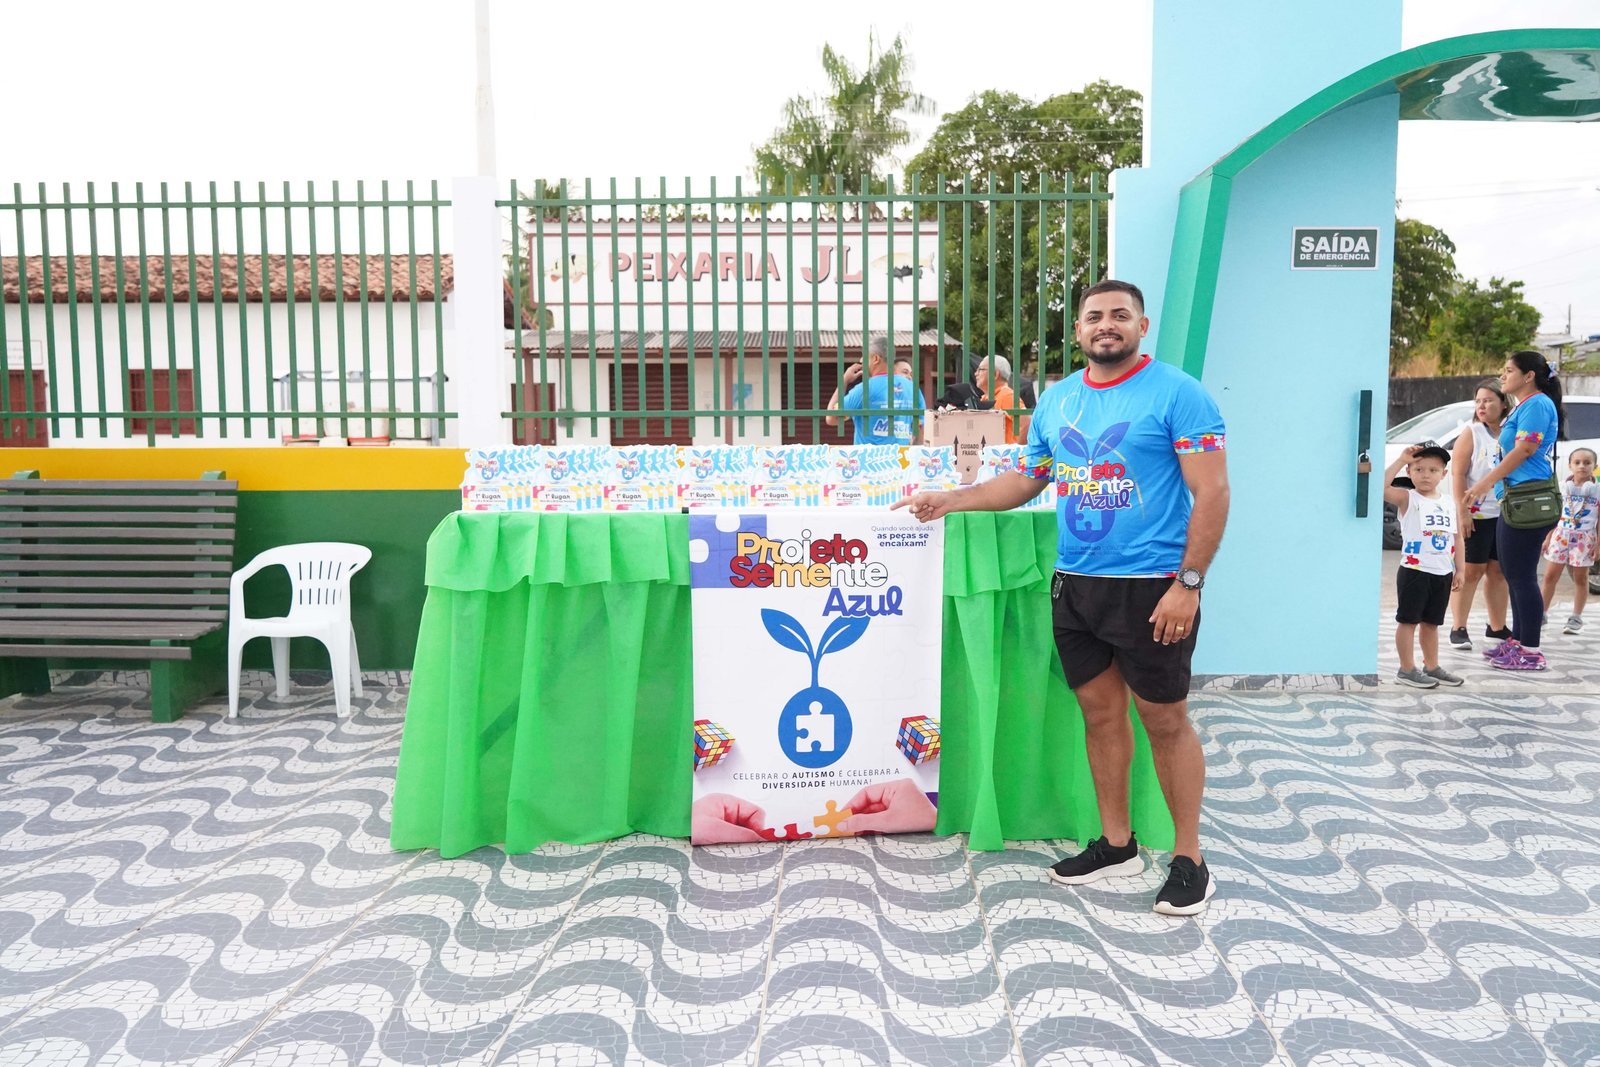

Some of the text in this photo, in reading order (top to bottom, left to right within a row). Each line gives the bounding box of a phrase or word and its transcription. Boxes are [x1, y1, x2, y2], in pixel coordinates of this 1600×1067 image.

[1300, 233, 1370, 253] SAÍDA
[608, 245, 863, 285] PEIXARIA JL
[1313, 251, 1370, 260] EMERGÊNCIA
[1056, 460, 1126, 483] Projeto
[1079, 488, 1132, 511] Azul
[1425, 515, 1450, 527] 333
[736, 529, 868, 566] Projeto
[890, 533, 916, 541] peças
[729, 556, 888, 588] Semente
[822, 586, 903, 617] Azul
[733, 772, 778, 780] CELEBRAR
[792, 770, 835, 779] AUTISMO
[847, 768, 891, 777] CELEBRAR
[894, 767, 900, 775] A
[762, 779, 872, 789] DIVERSIDADE HUMANA!
